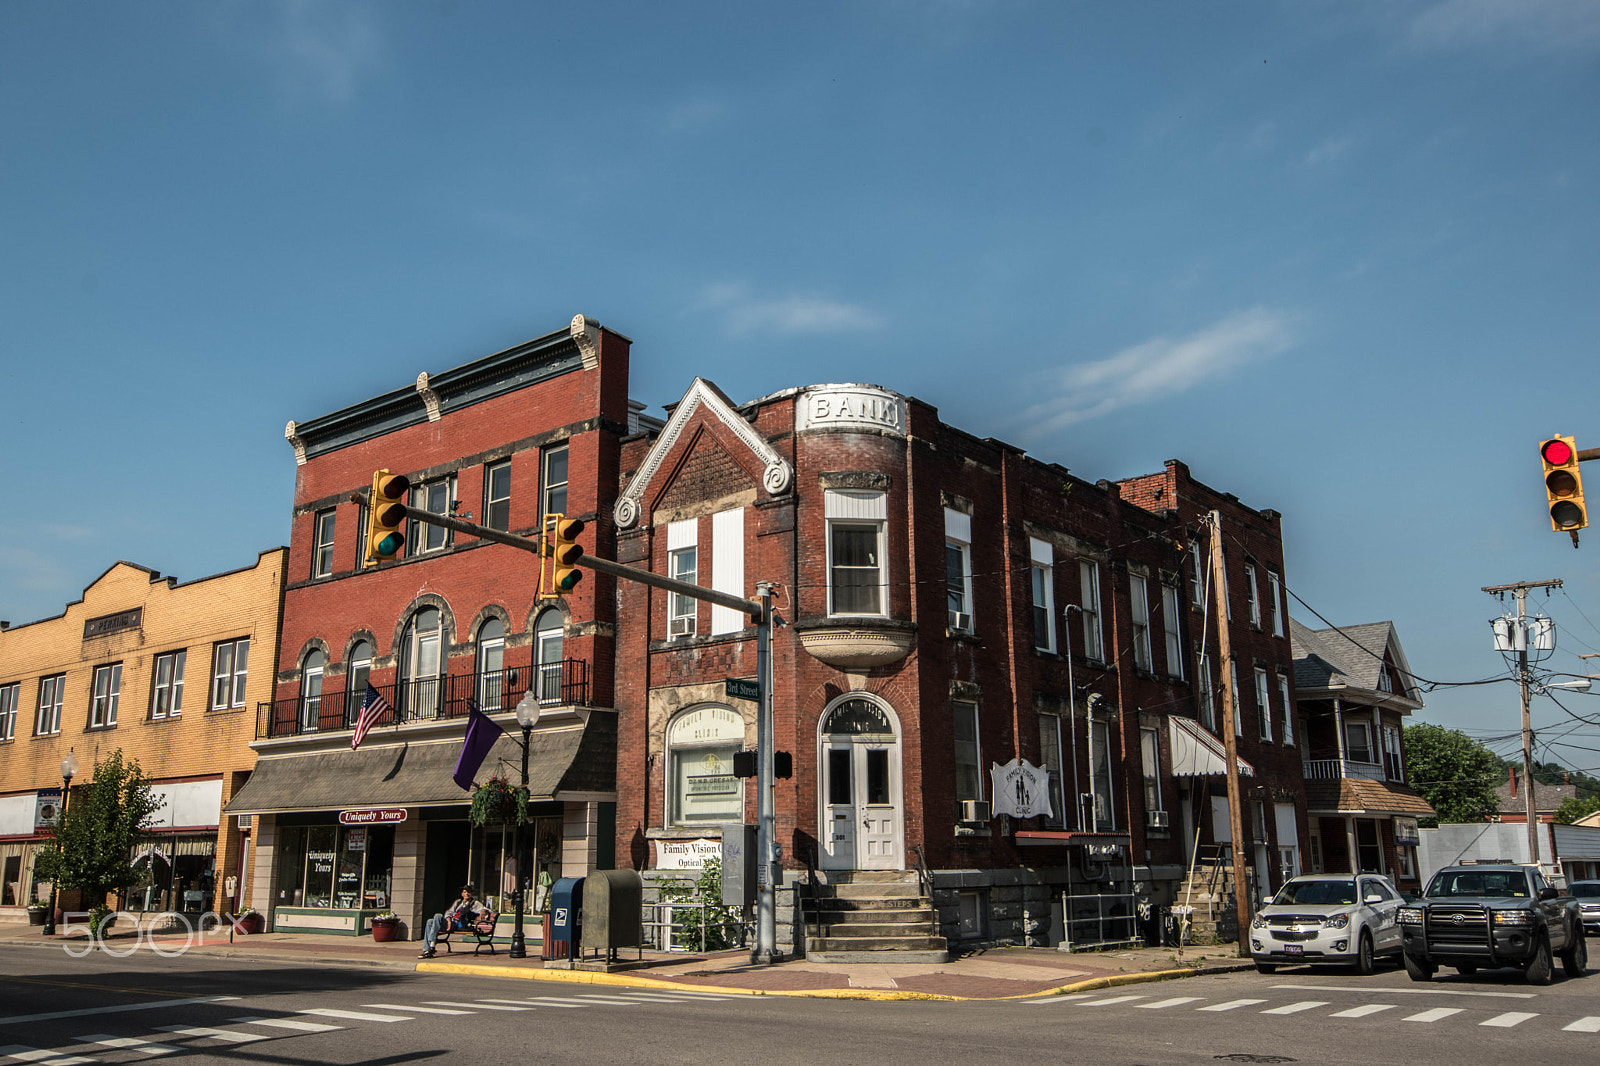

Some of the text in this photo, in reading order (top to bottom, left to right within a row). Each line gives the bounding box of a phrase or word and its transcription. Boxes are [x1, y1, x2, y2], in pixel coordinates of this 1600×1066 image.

[814, 397, 894, 422] BANK
[98, 615, 129, 631] PERKINS
[727, 681, 758, 697] 3rd Street
[345, 811, 401, 822] Uniquely Yours
[663, 843, 689, 855] Family
[691, 843, 717, 854] Vision
[309, 849, 334, 862] Uniquely
[315, 862, 332, 872] Yours
[678, 858, 702, 868] Optical
[887, 900, 913, 908] STEPS
